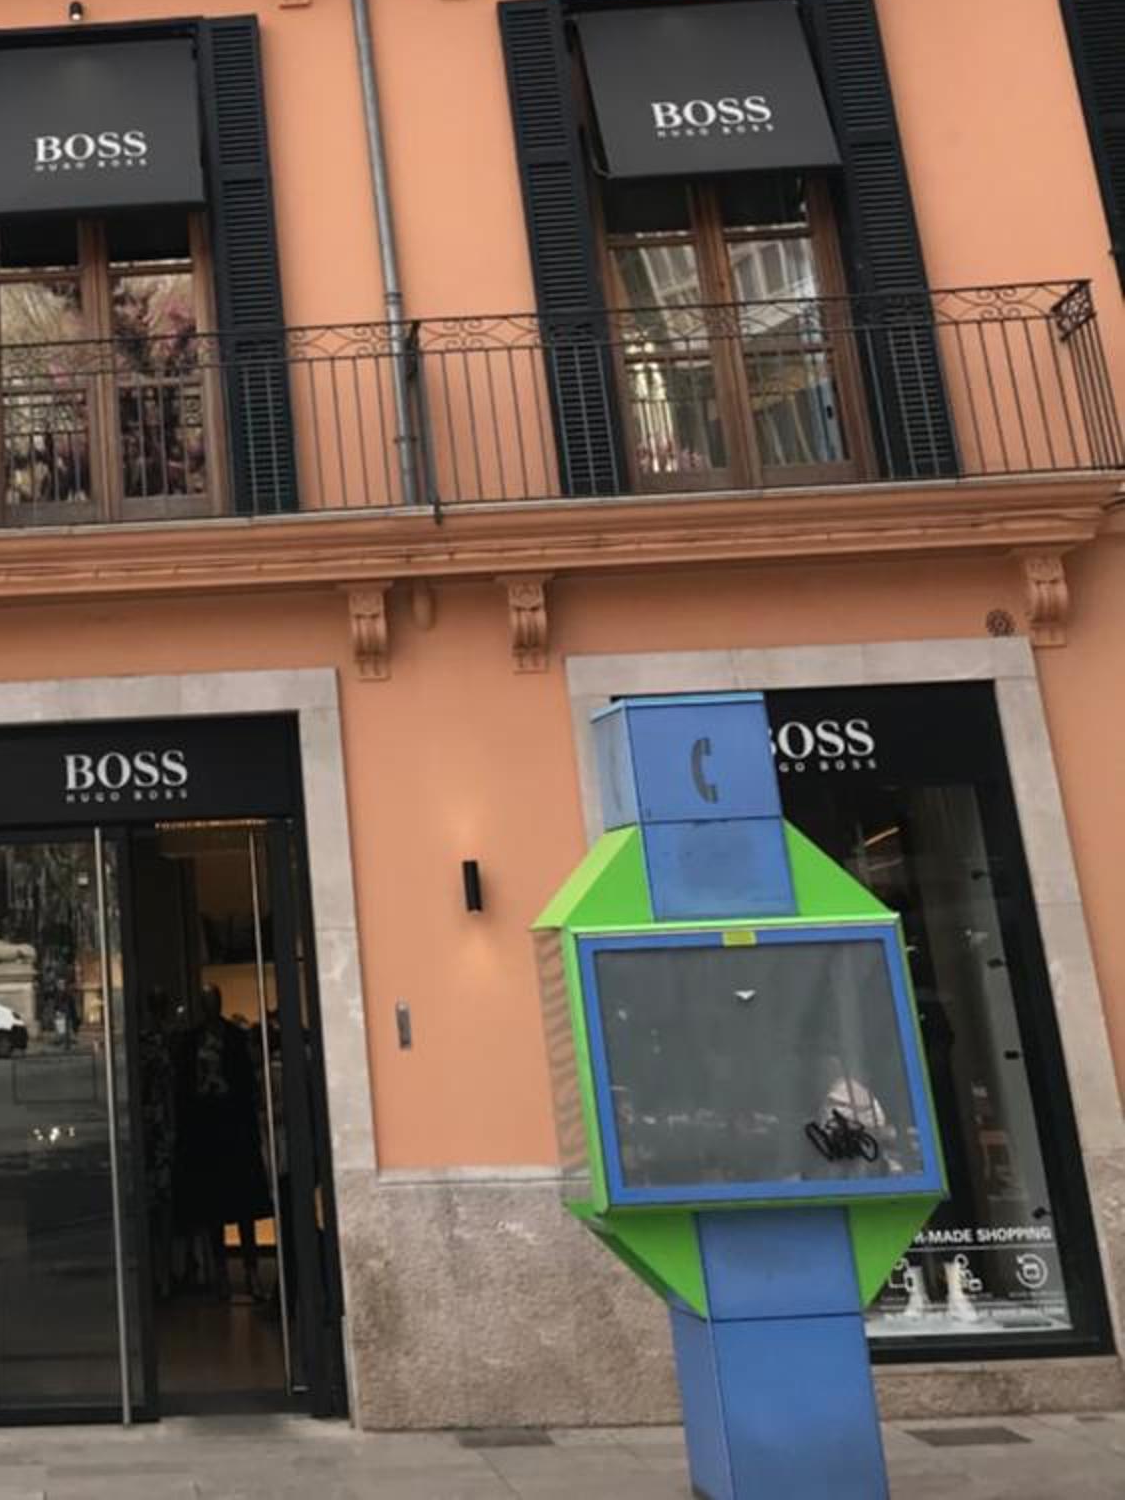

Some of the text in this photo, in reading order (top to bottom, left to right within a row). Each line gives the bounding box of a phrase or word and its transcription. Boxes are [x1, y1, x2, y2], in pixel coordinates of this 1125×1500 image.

[651, 95, 772, 128] BOSS
[35, 131, 147, 162] BOSS
[768, 719, 875, 759] OSS
[64, 749, 188, 790] BOSS
[976, 1225, 1052, 1243] SHOPPING
